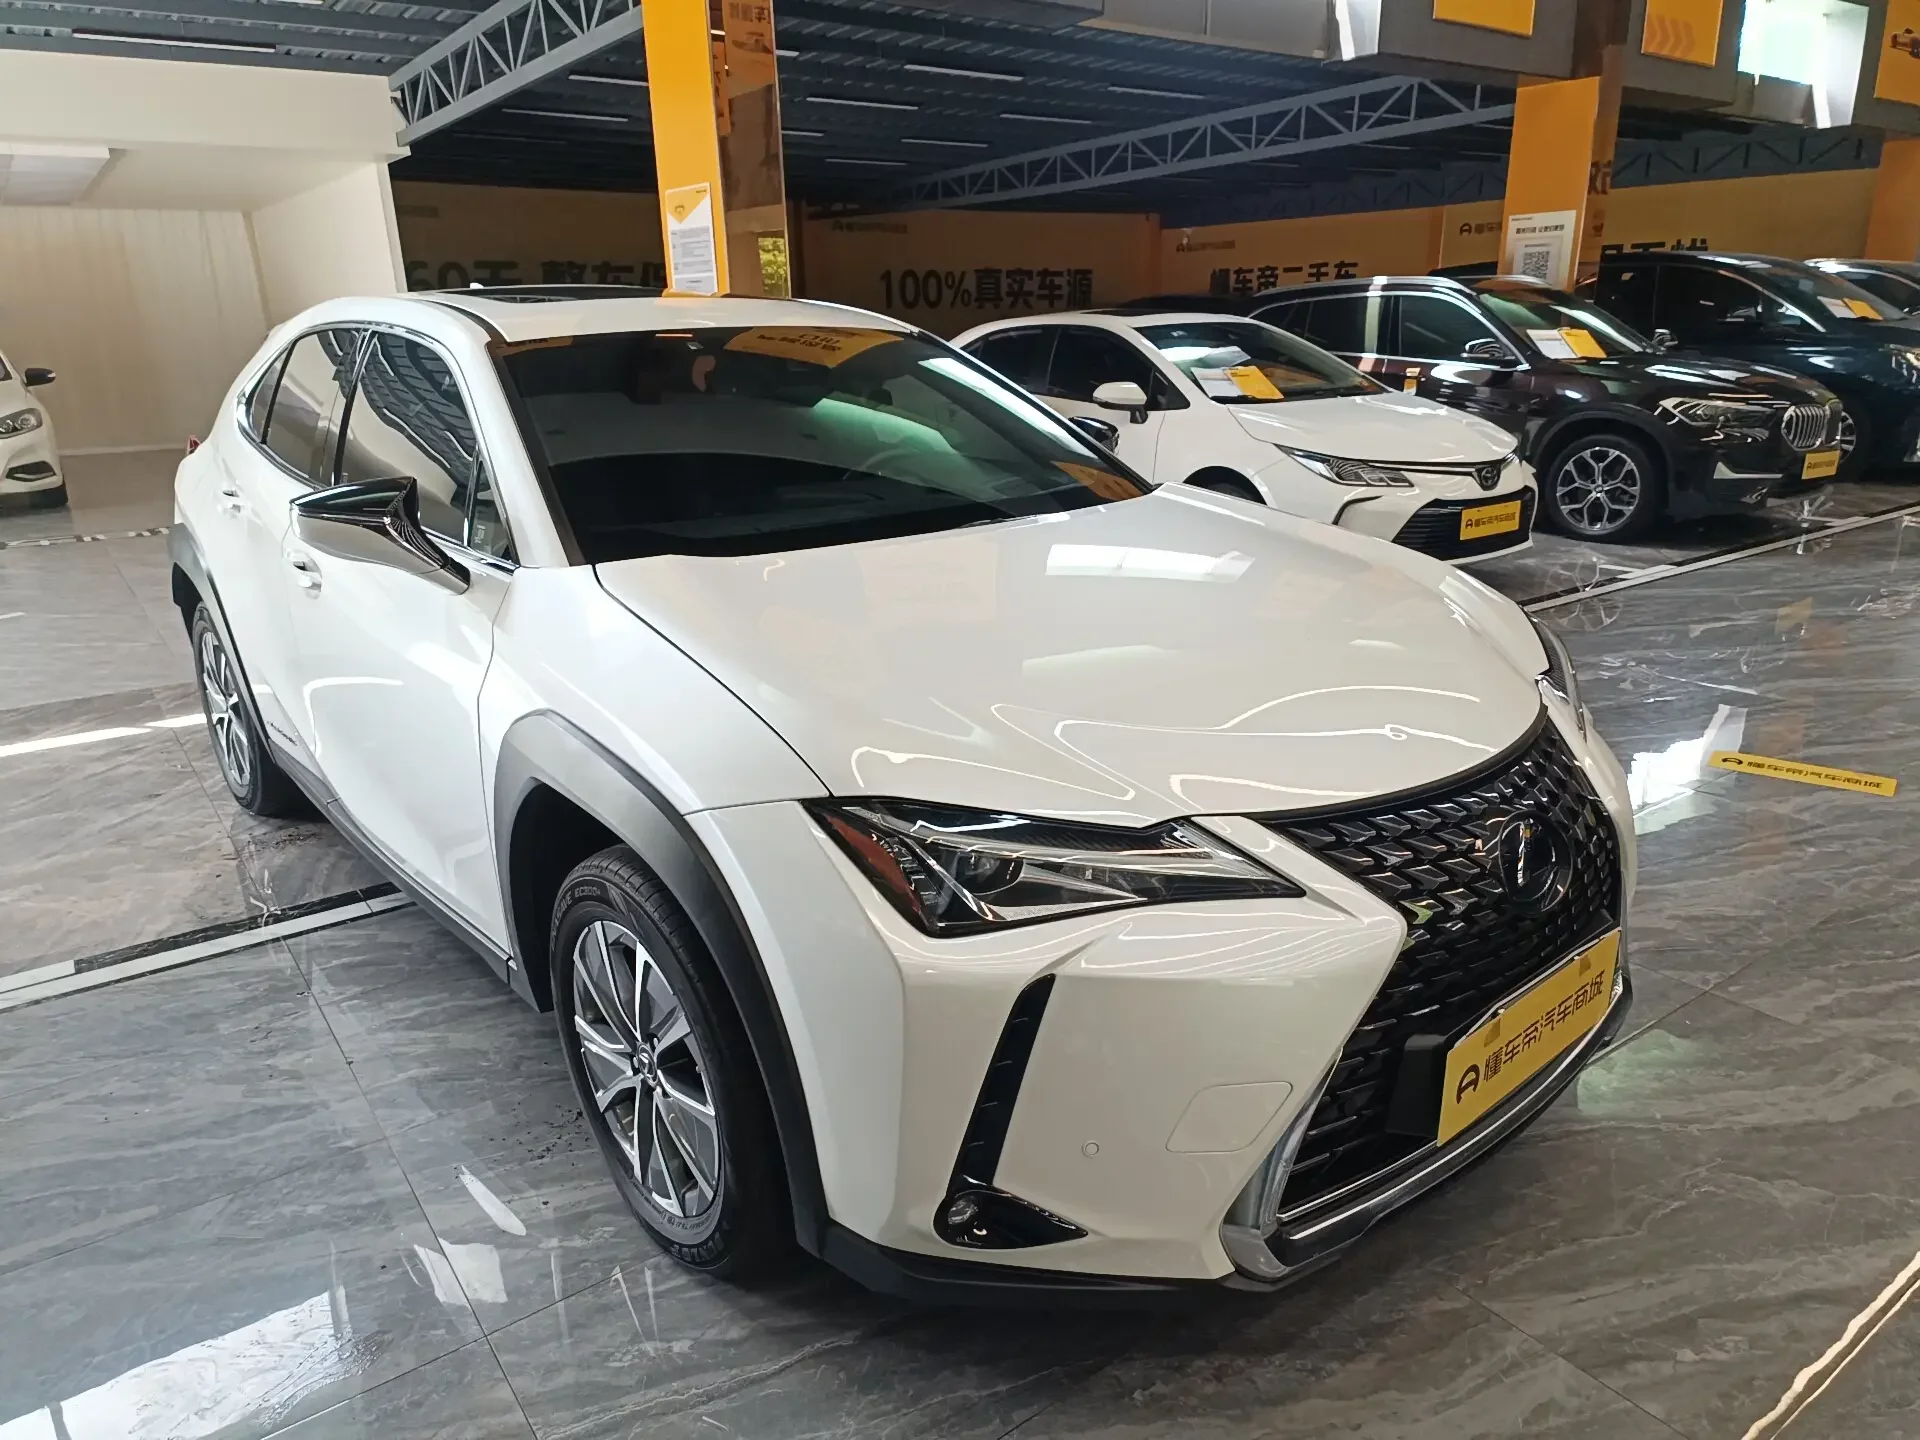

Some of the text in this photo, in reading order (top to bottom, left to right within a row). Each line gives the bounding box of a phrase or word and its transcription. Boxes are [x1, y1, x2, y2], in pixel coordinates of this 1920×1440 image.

[880, 268, 1093, 310] 100%真实车源
[1483, 969, 1606, 1083] 懂车帝汽车商城
